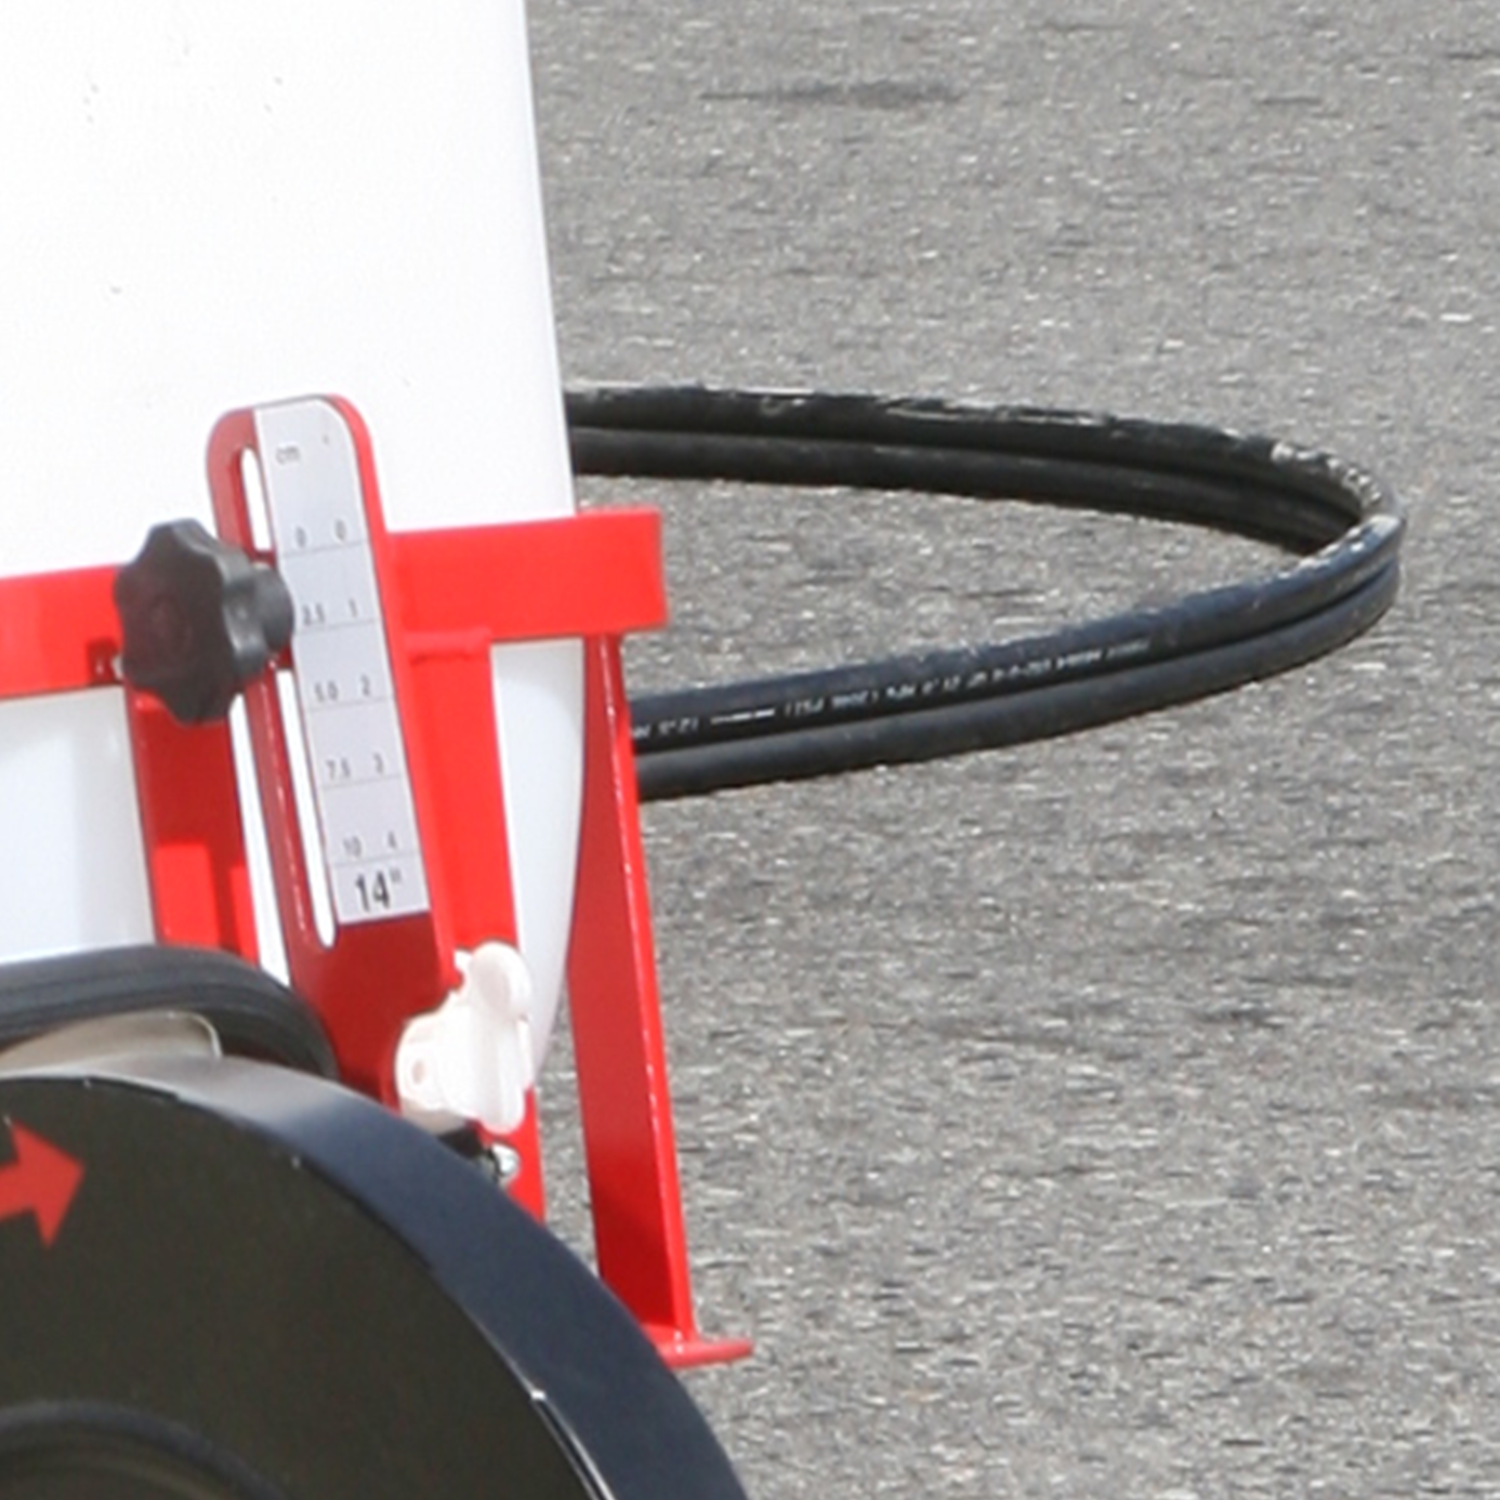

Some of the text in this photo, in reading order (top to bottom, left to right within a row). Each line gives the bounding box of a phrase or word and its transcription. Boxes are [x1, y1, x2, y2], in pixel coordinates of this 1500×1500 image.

[275, 446, 300, 465] cm
[335, 518, 347, 541] 0
[348, 597, 358, 619] 1
[360, 673, 370, 697] 2
